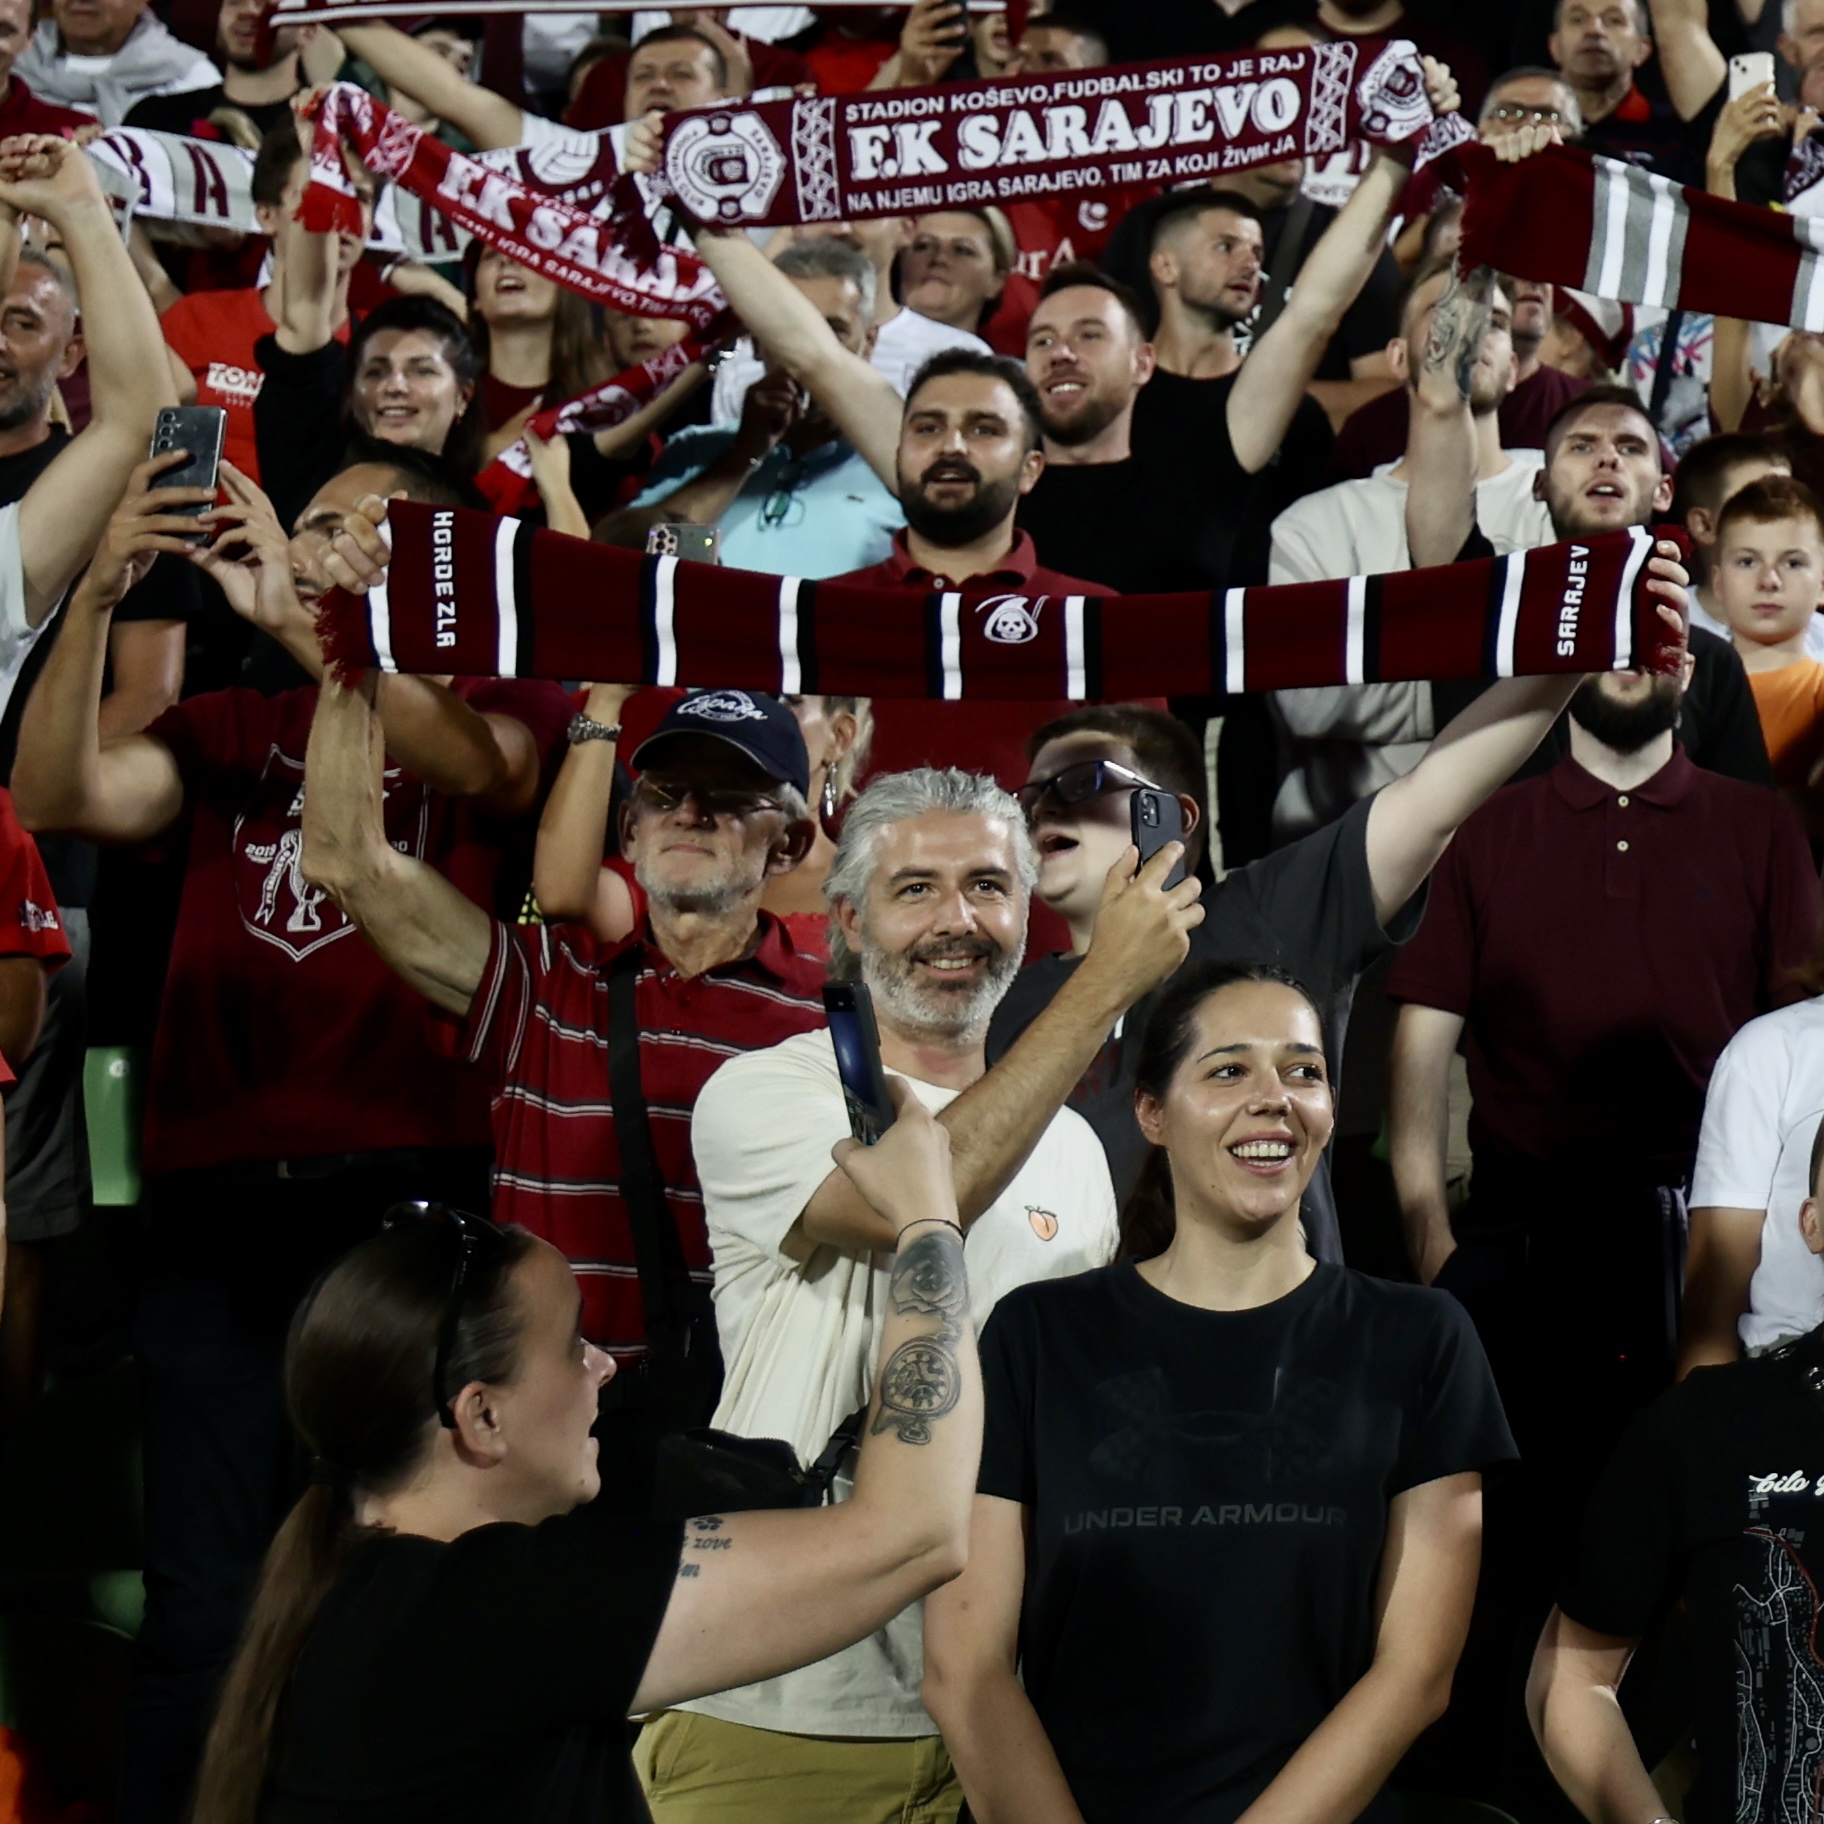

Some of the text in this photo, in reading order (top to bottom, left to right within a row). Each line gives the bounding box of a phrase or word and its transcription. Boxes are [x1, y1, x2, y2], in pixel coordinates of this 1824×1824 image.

[844, 95, 946, 124] STADION
[1188, 62, 1220, 86] TO
[1224, 58, 1256, 82] JE
[1259, 50, 1306, 77] RAJ
[956, 75, 1302, 171] SARAJEVO
[846, 192, 873, 214] NA
[877, 185, 944, 212] NJEMU
[947, 180, 995, 207] IGRA
[1109, 162, 1142, 185] TIM
[1145, 160, 1174, 180] ZA
[1177, 151, 1220, 177] KOJI
[1273, 135, 1297, 155] JA
[432, 510, 458, 650] HORDE ZLA
[1062, 1502, 1350, 1536] UNDER ARMOUR
